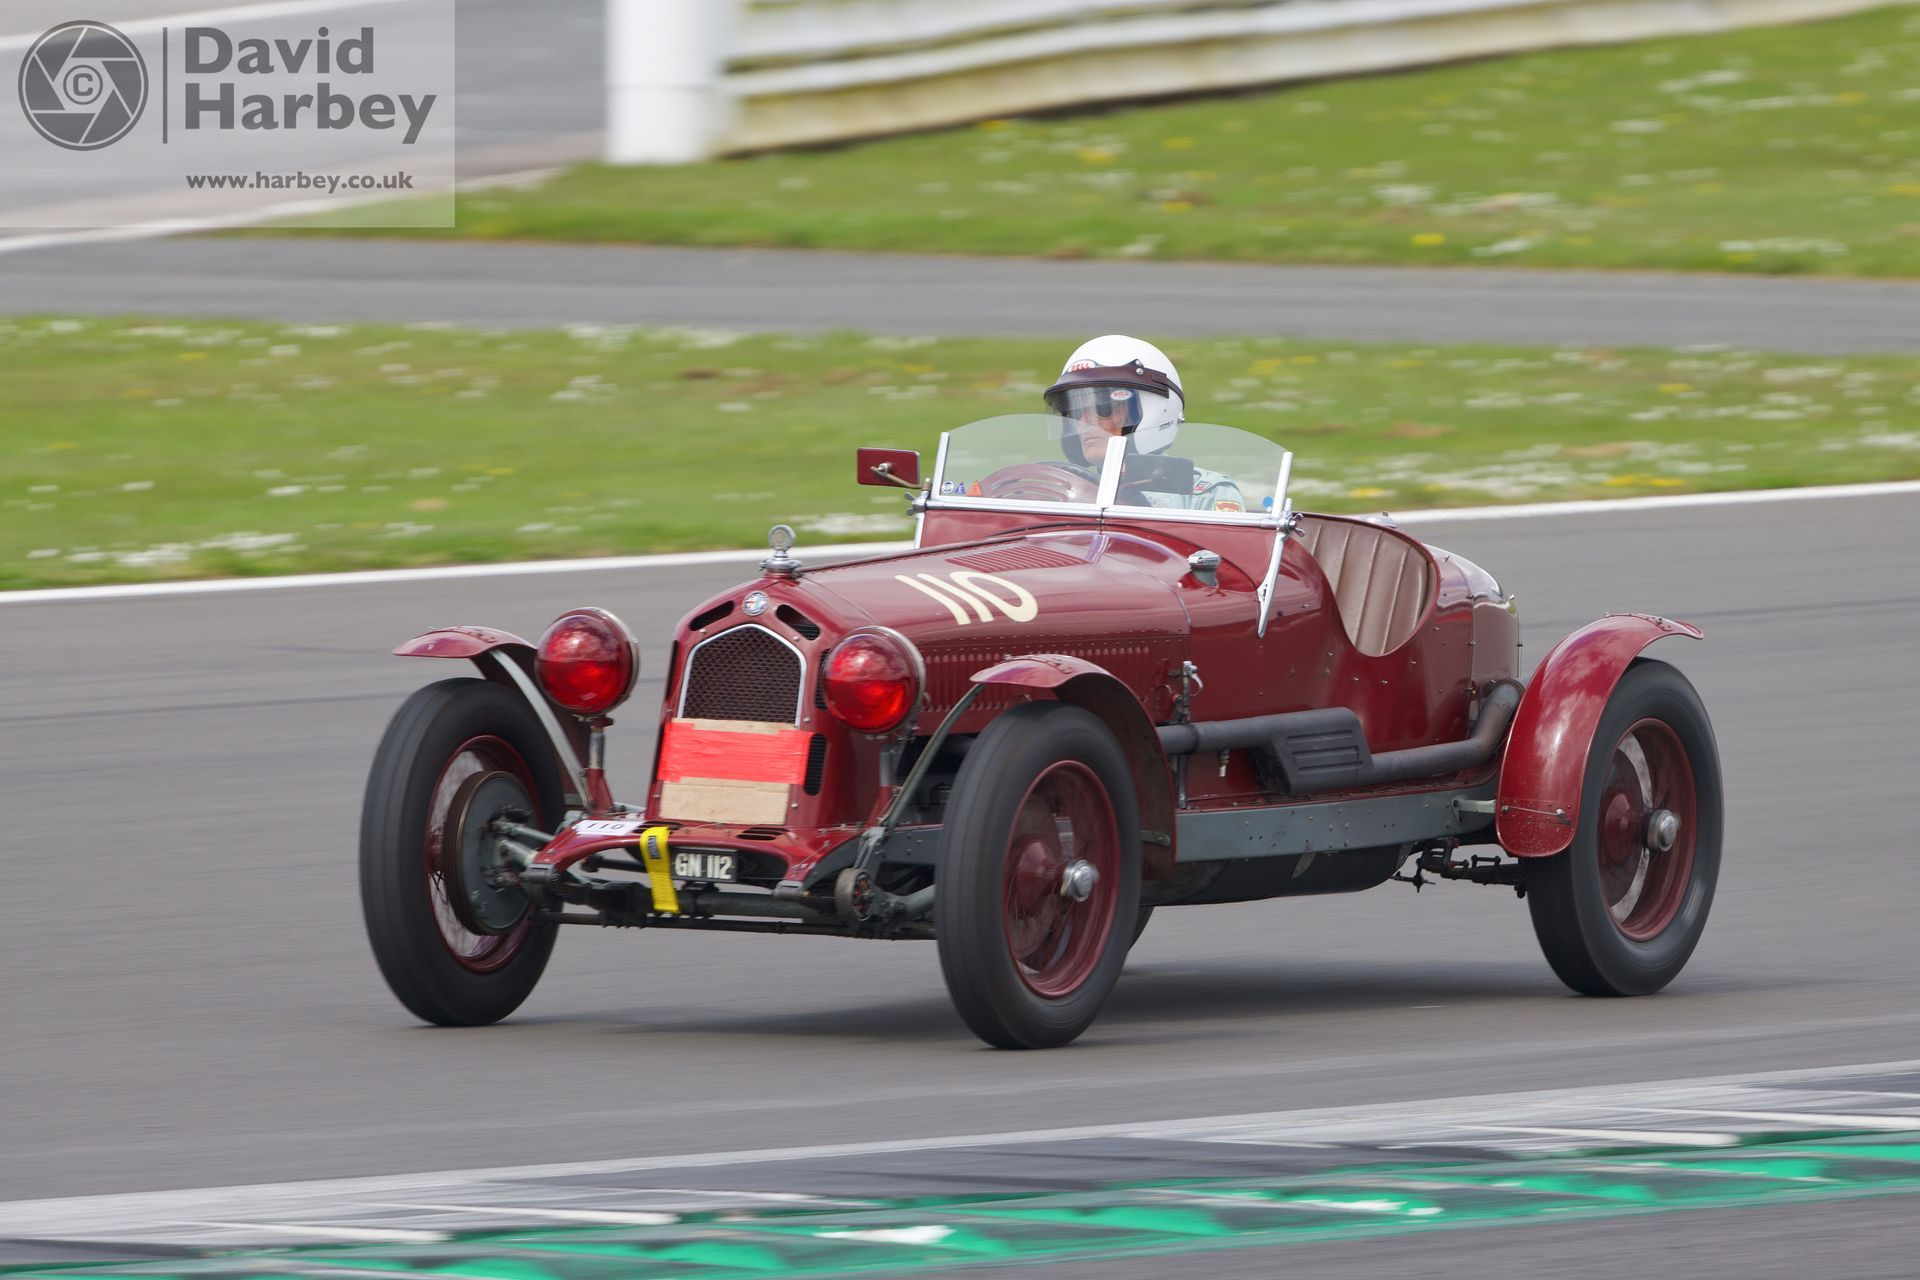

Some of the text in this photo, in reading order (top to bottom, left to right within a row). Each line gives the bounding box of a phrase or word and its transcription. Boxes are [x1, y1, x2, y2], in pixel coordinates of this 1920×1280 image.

[894, 571, 1039, 626] 110
[586, 822, 625, 830] 110
[674, 853, 733, 880] GN 112
